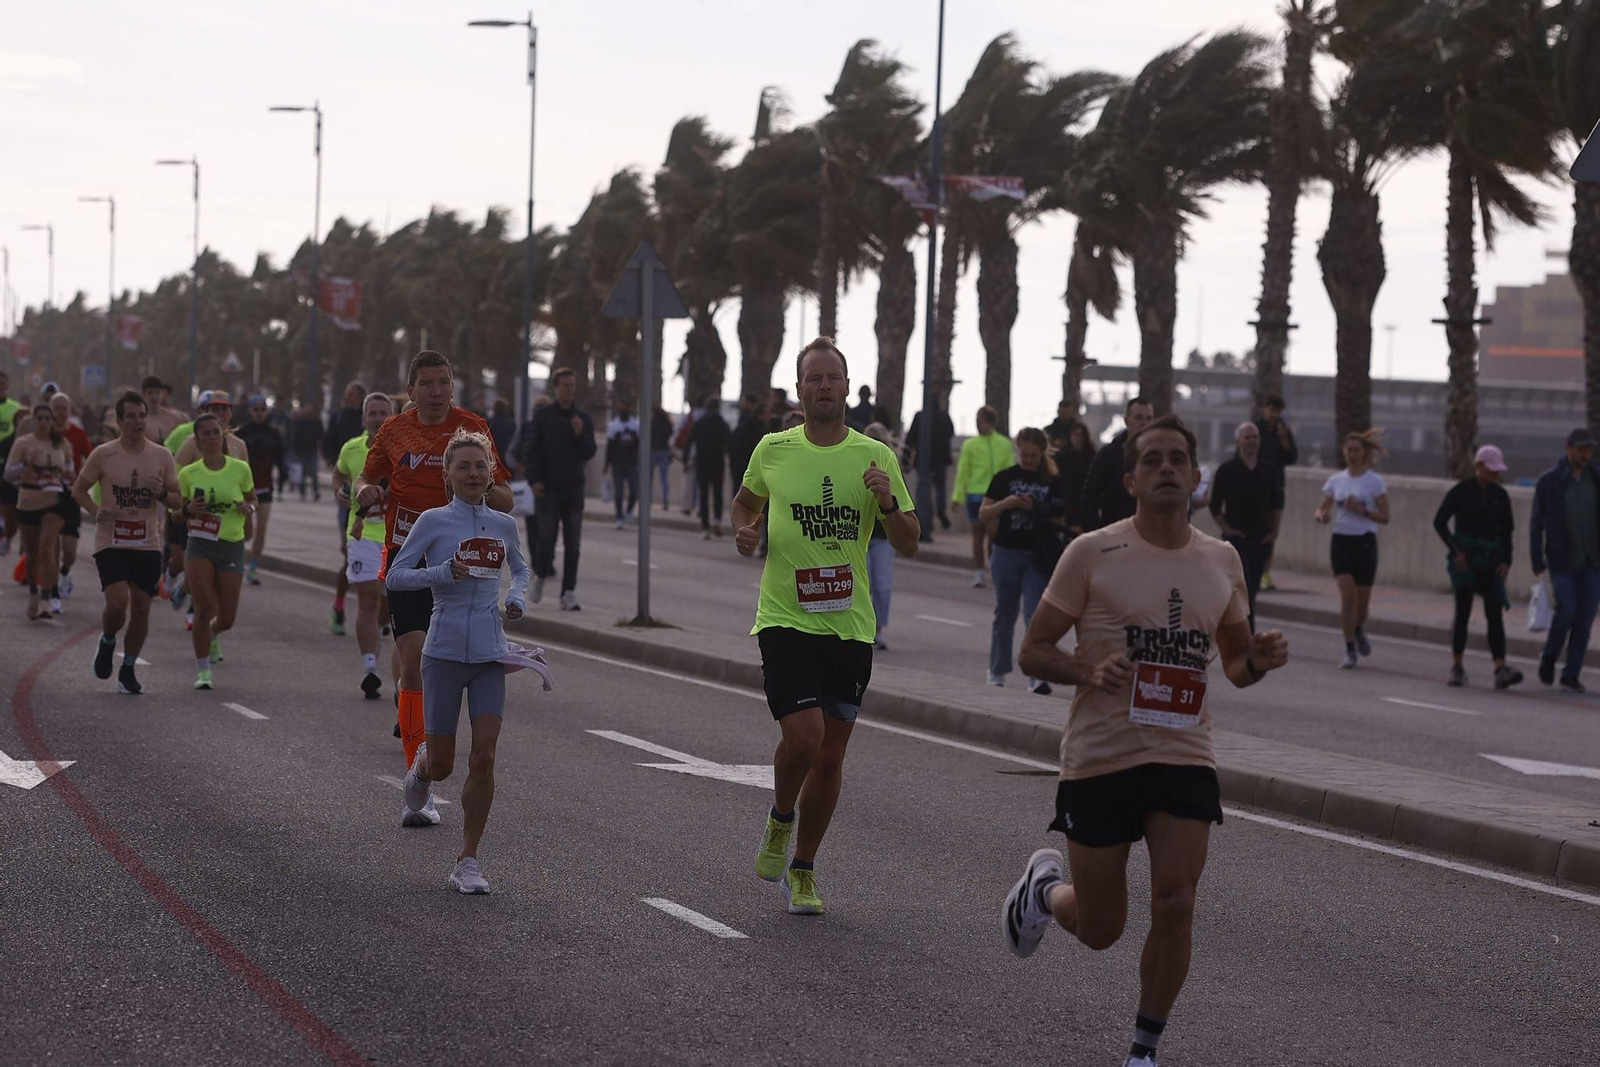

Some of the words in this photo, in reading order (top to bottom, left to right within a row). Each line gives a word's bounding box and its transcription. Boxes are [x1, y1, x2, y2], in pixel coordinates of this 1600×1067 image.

[790, 503, 861, 526] BRUNCH
[800, 520, 837, 541] RUN
[486, 551, 499, 562] 43
[826, 579, 852, 592] 1299
[1180, 689, 1195, 704] 31
